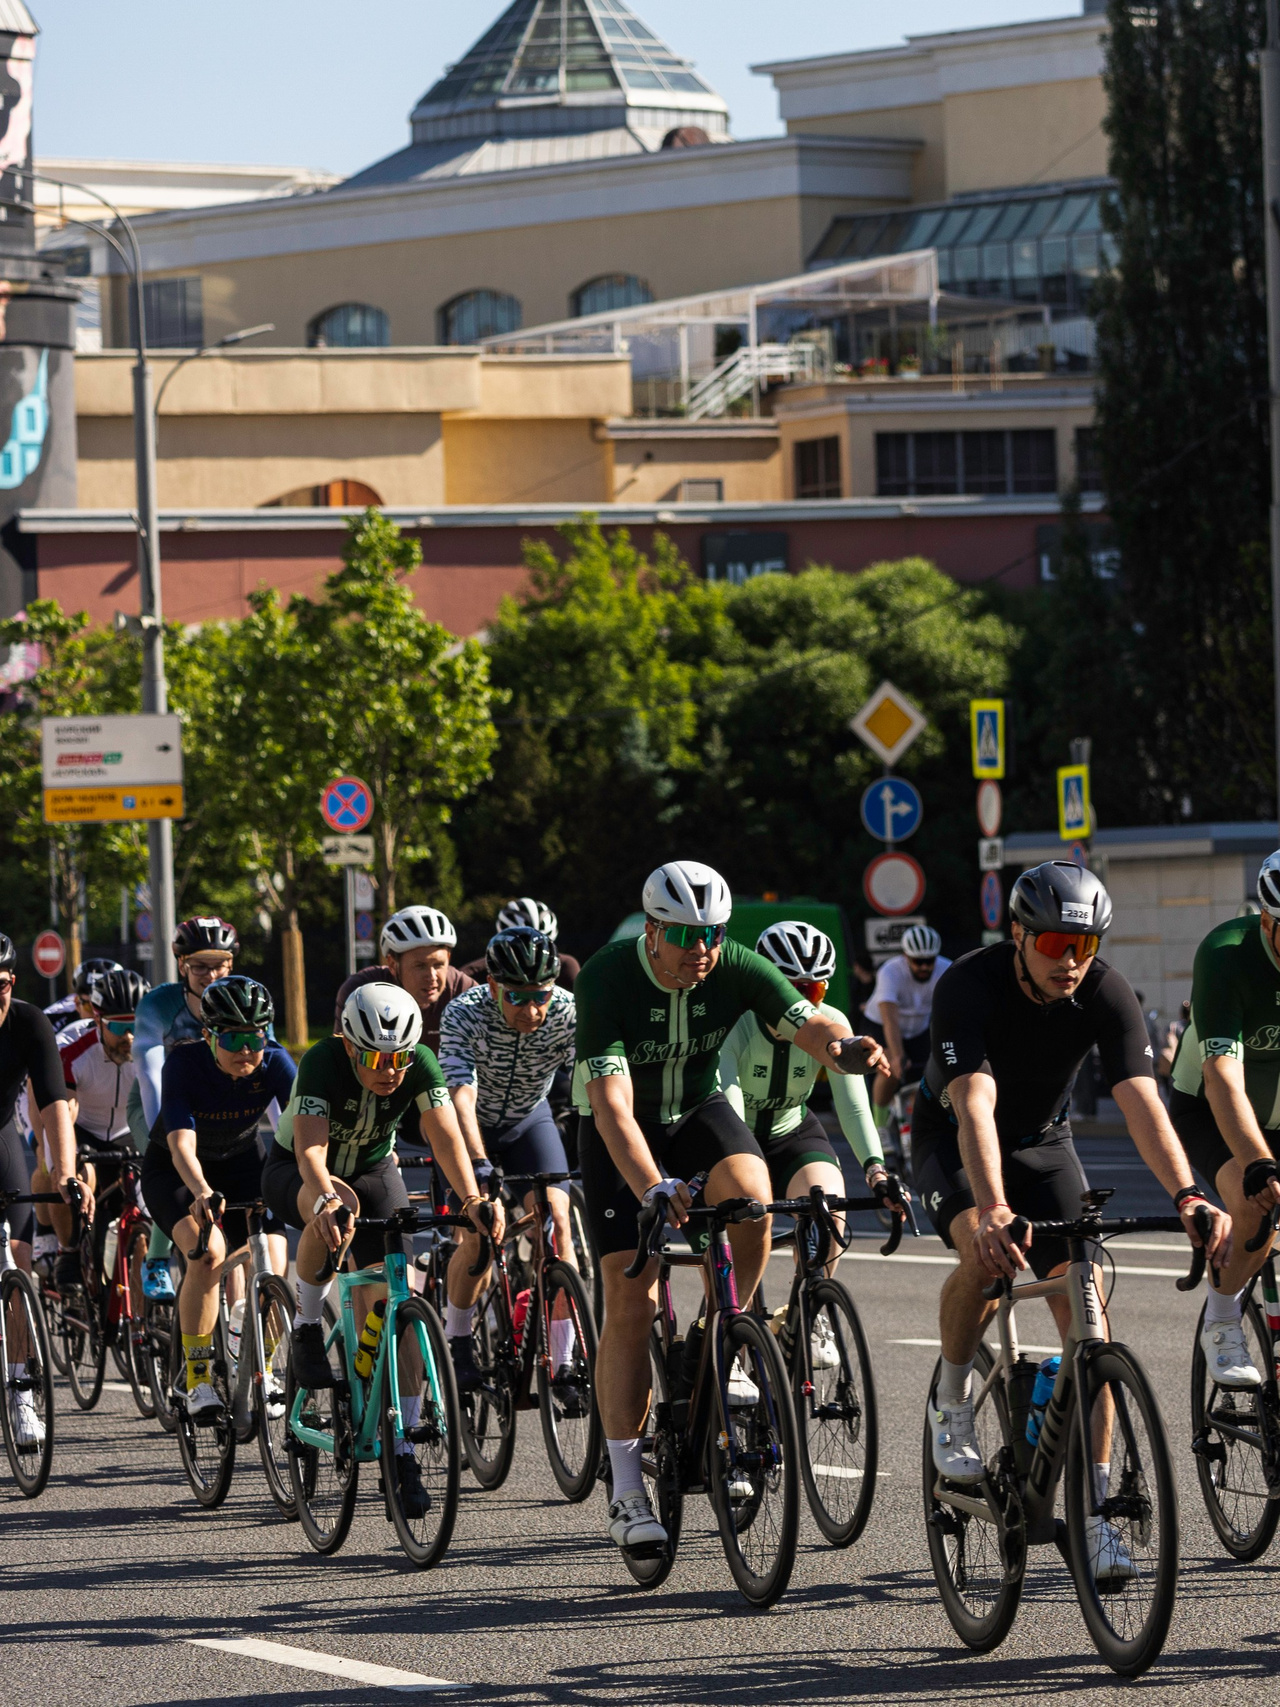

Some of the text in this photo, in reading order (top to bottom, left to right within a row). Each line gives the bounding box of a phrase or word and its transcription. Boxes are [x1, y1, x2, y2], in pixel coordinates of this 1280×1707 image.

[1067, 909, 1089, 919] 2326
[628, 1026, 727, 1065] SKILL UP
[942, 1042, 957, 1066] EVR
